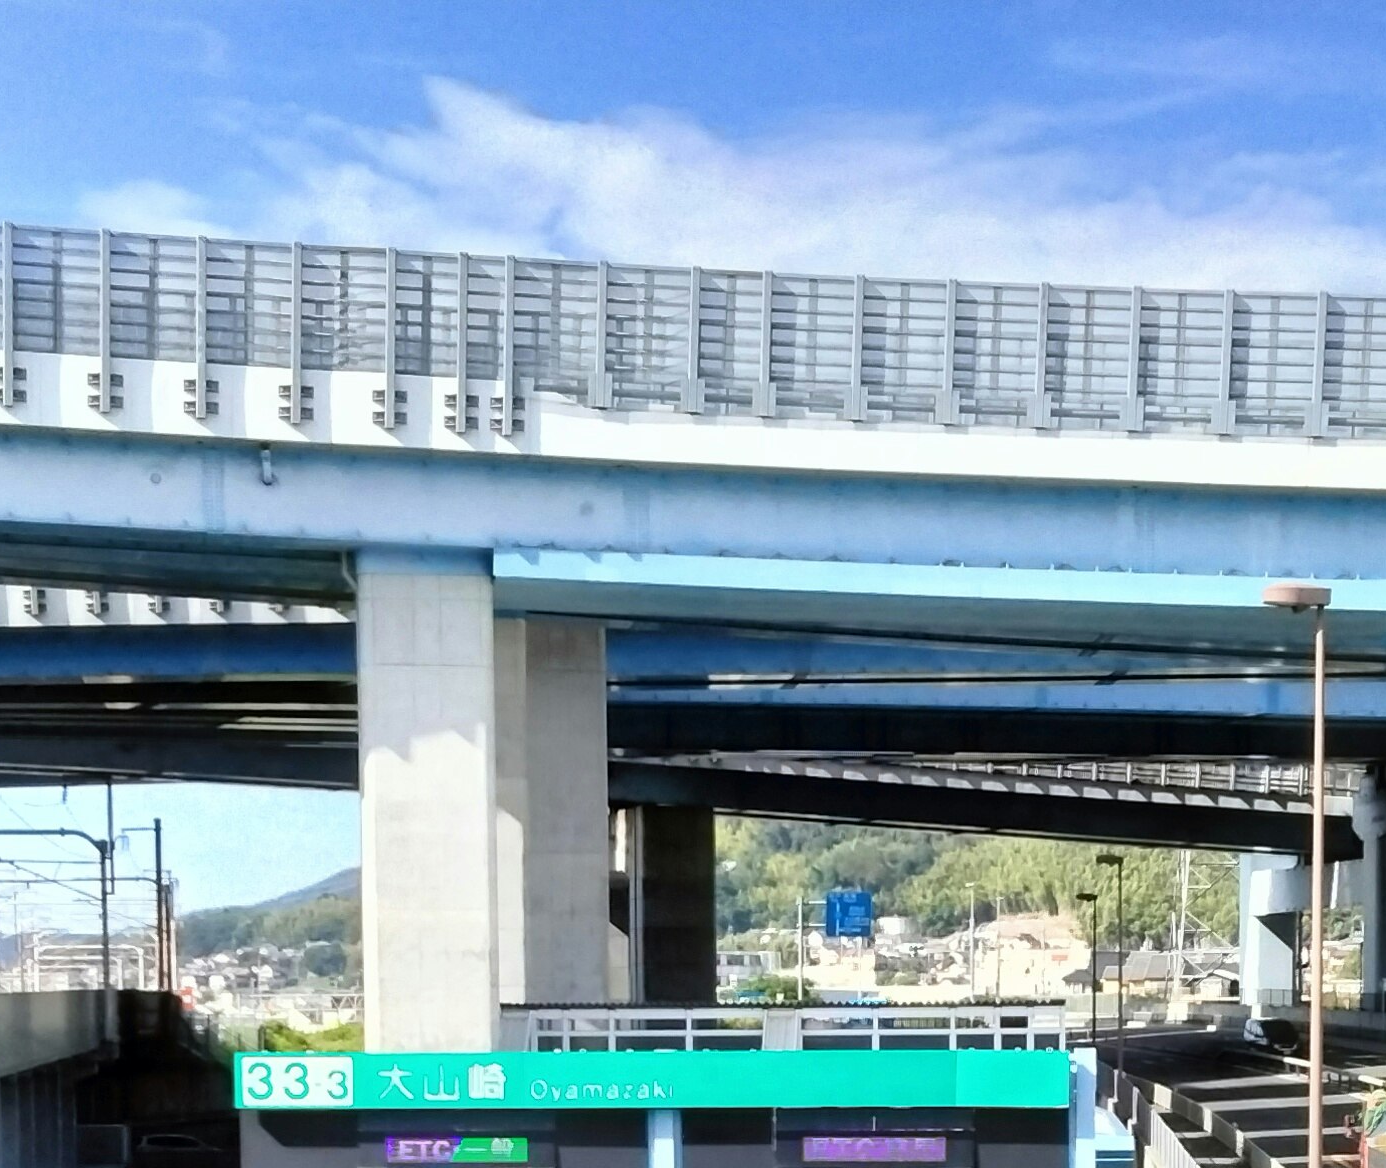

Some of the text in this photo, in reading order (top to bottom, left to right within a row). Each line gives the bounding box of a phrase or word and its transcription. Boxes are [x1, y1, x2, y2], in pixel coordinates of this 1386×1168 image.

[377, 1063, 507, 1101] 大山崎
[530, 1079, 673, 1101] Oyamazaki
[398, 1140, 451, 1160] ETC
